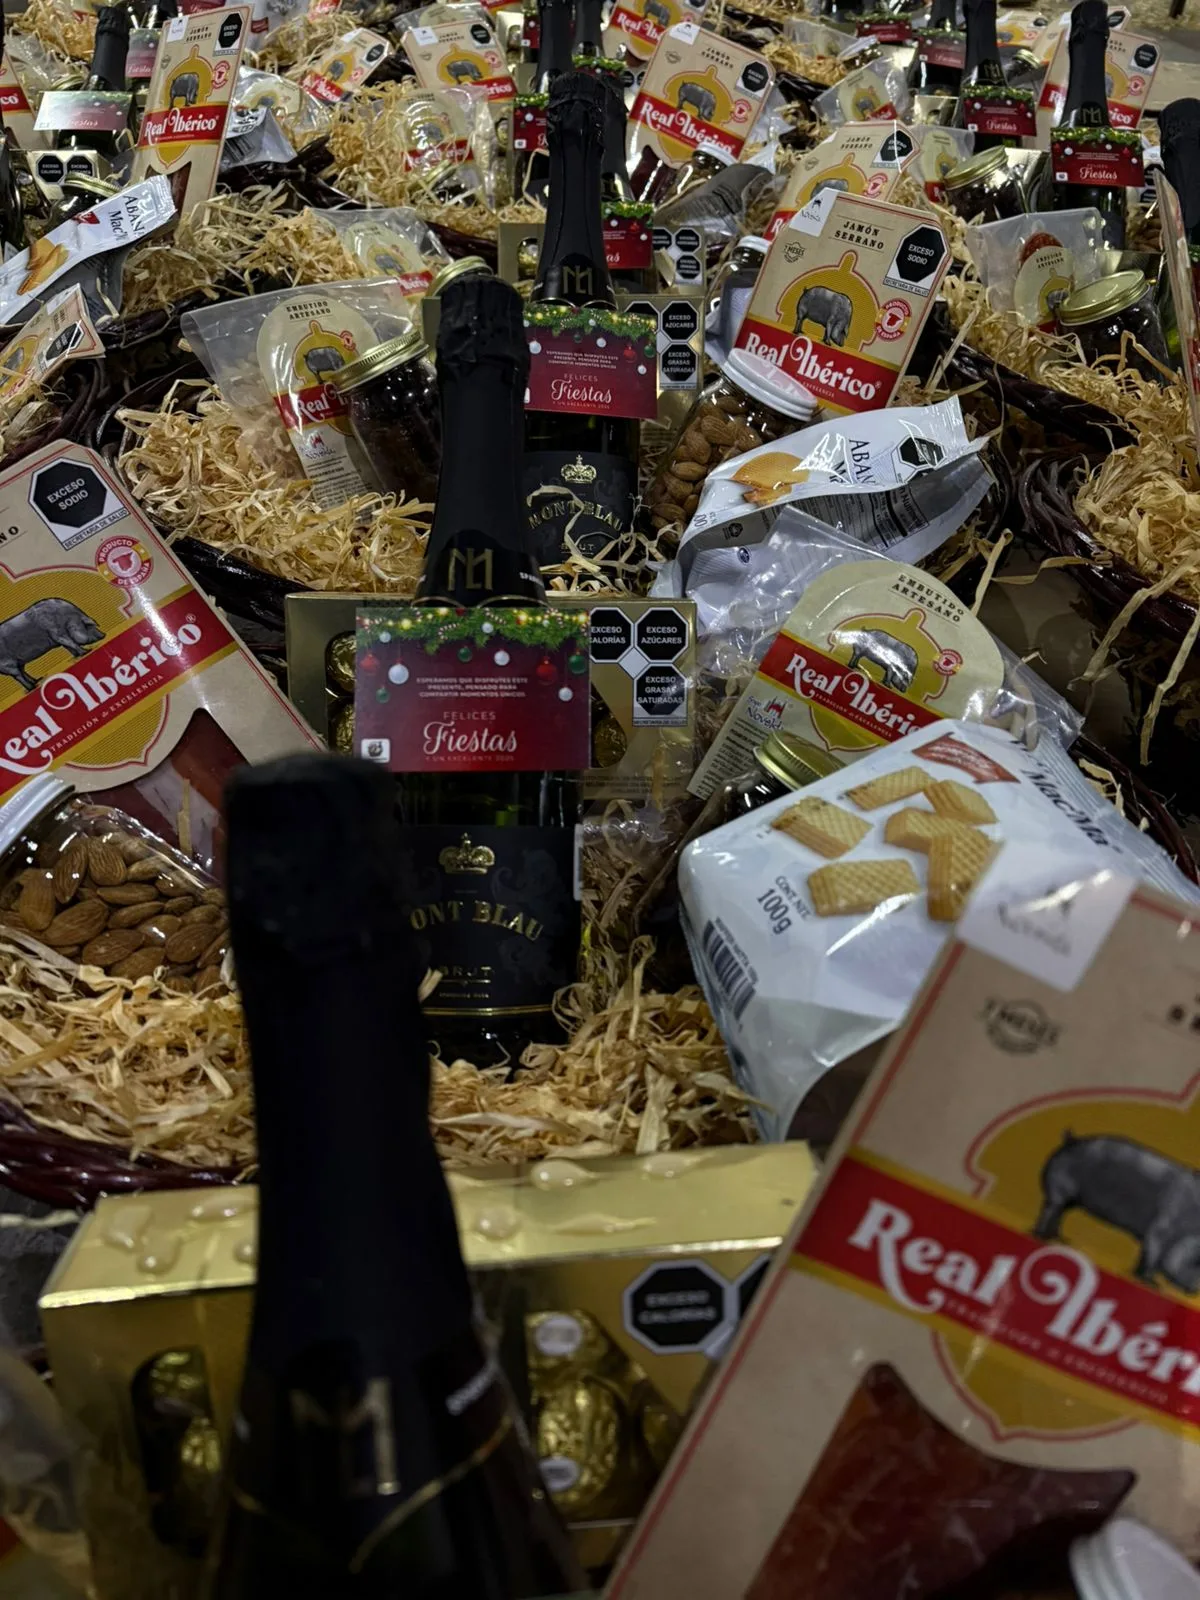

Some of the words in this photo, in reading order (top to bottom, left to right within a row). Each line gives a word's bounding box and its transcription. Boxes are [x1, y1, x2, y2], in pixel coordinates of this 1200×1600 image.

[617, 12, 643, 32] Real
[145, 118, 167, 146] Real
[168, 107, 217, 133] Ibérico
[641, 101, 675, 132] Real
[1079, 166, 1118, 180] Fiestas
[834, 230, 884, 249] SERRANO
[843, 220, 880, 237] JAMÓN
[907, 253, 928, 266] SODIO
[908, 243, 935, 258] EXCESO
[289, 308, 332, 321] ARTESANO
[564, 373, 598, 382] FELICES
[790, 336, 876, 401] Ibérico
[551, 379, 612, 404] Fiestas
[297, 393, 331, 423] Real
[46, 477, 86, 504] EXCESO
[58, 489, 89, 511] SODIO
[99, 539, 133, 563] PRODUCTO
[560, 543, 596, 551] BUT
[891, 583, 962, 623] ARTESANO
[897, 573, 965, 616] EMBUTIDO
[591, 626, 622, 634] EXCESO
[641, 635, 683, 644] AZÚCARES
[646, 626, 678, 634] EXCESO
[0, 705, 63, 775] eal
[40, 623, 202, 712] Ibérico
[637, 696, 683, 704] SATURADAS
[785, 653, 842, 700] Real
[842, 671, 920, 738] Ibéri
[51, 718, 99, 752] TRADICIÓN
[110, 673, 165, 712] EXCELENCIA
[443, 711, 496, 721] FELICES
[423, 721, 518, 755] Fiestas
[409, 900, 465, 931] ONT
[472, 900, 545, 942] BLAU
[757, 888, 792, 935] 100g
[847, 1198, 1017, 1314] Real
[1018, 1242, 1200, 1396] Ibér
